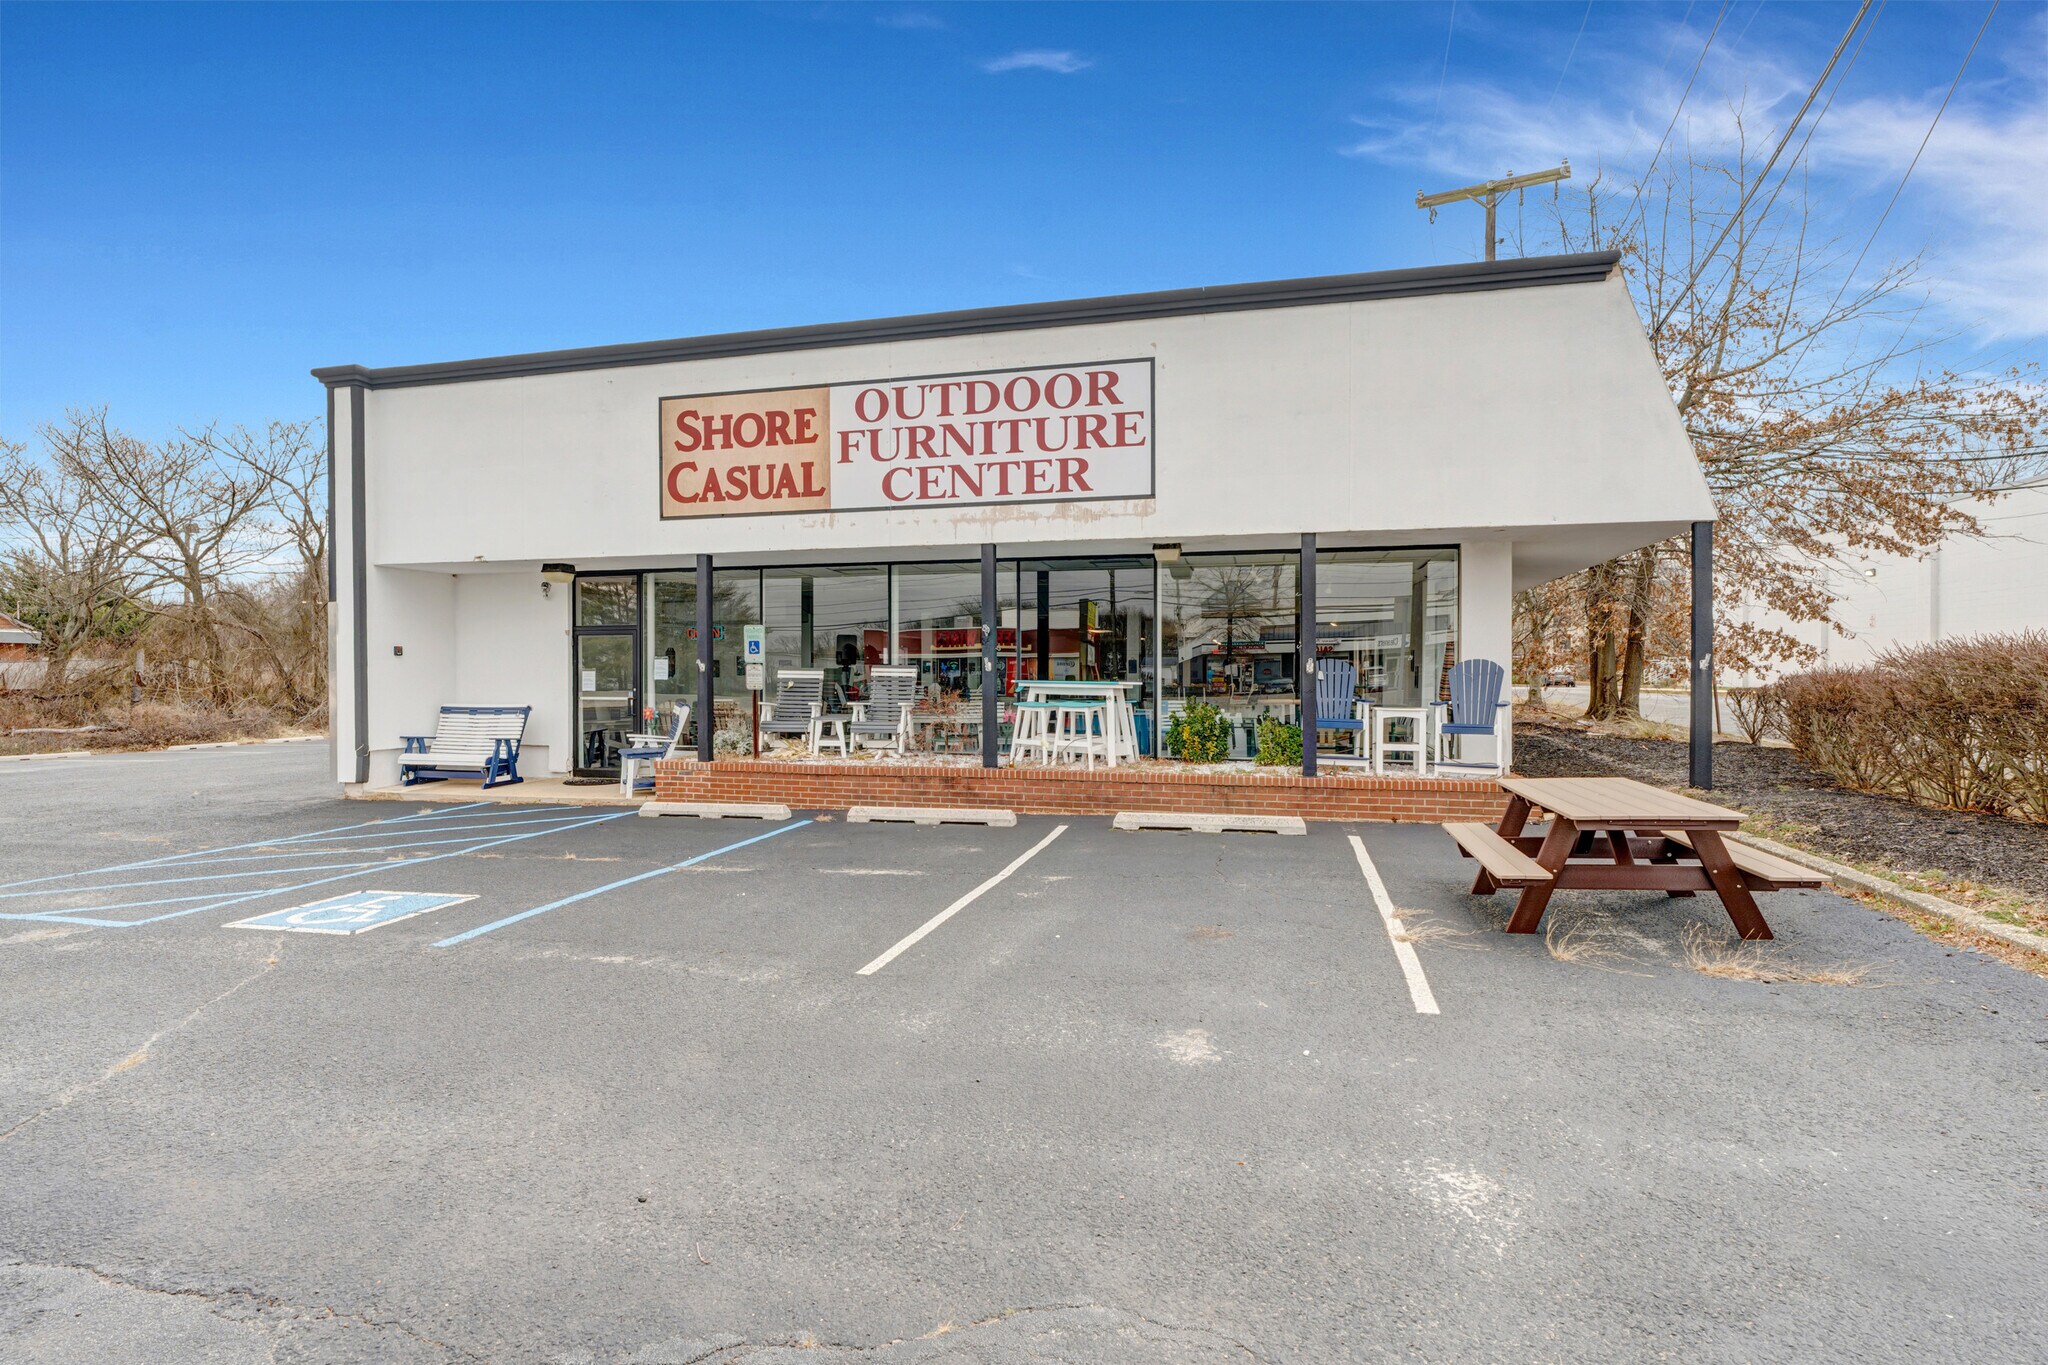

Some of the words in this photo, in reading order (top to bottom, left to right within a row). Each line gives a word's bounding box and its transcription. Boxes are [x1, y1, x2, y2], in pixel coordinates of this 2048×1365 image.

[855, 371, 1124, 423] OUTDOOR
[674, 408, 819, 452] SHORE
[837, 411, 1146, 464] FURNITURE
[667, 461, 826, 503] CASUAL
[882, 457, 1094, 502] CENTER
[687, 627, 721, 639] ON
